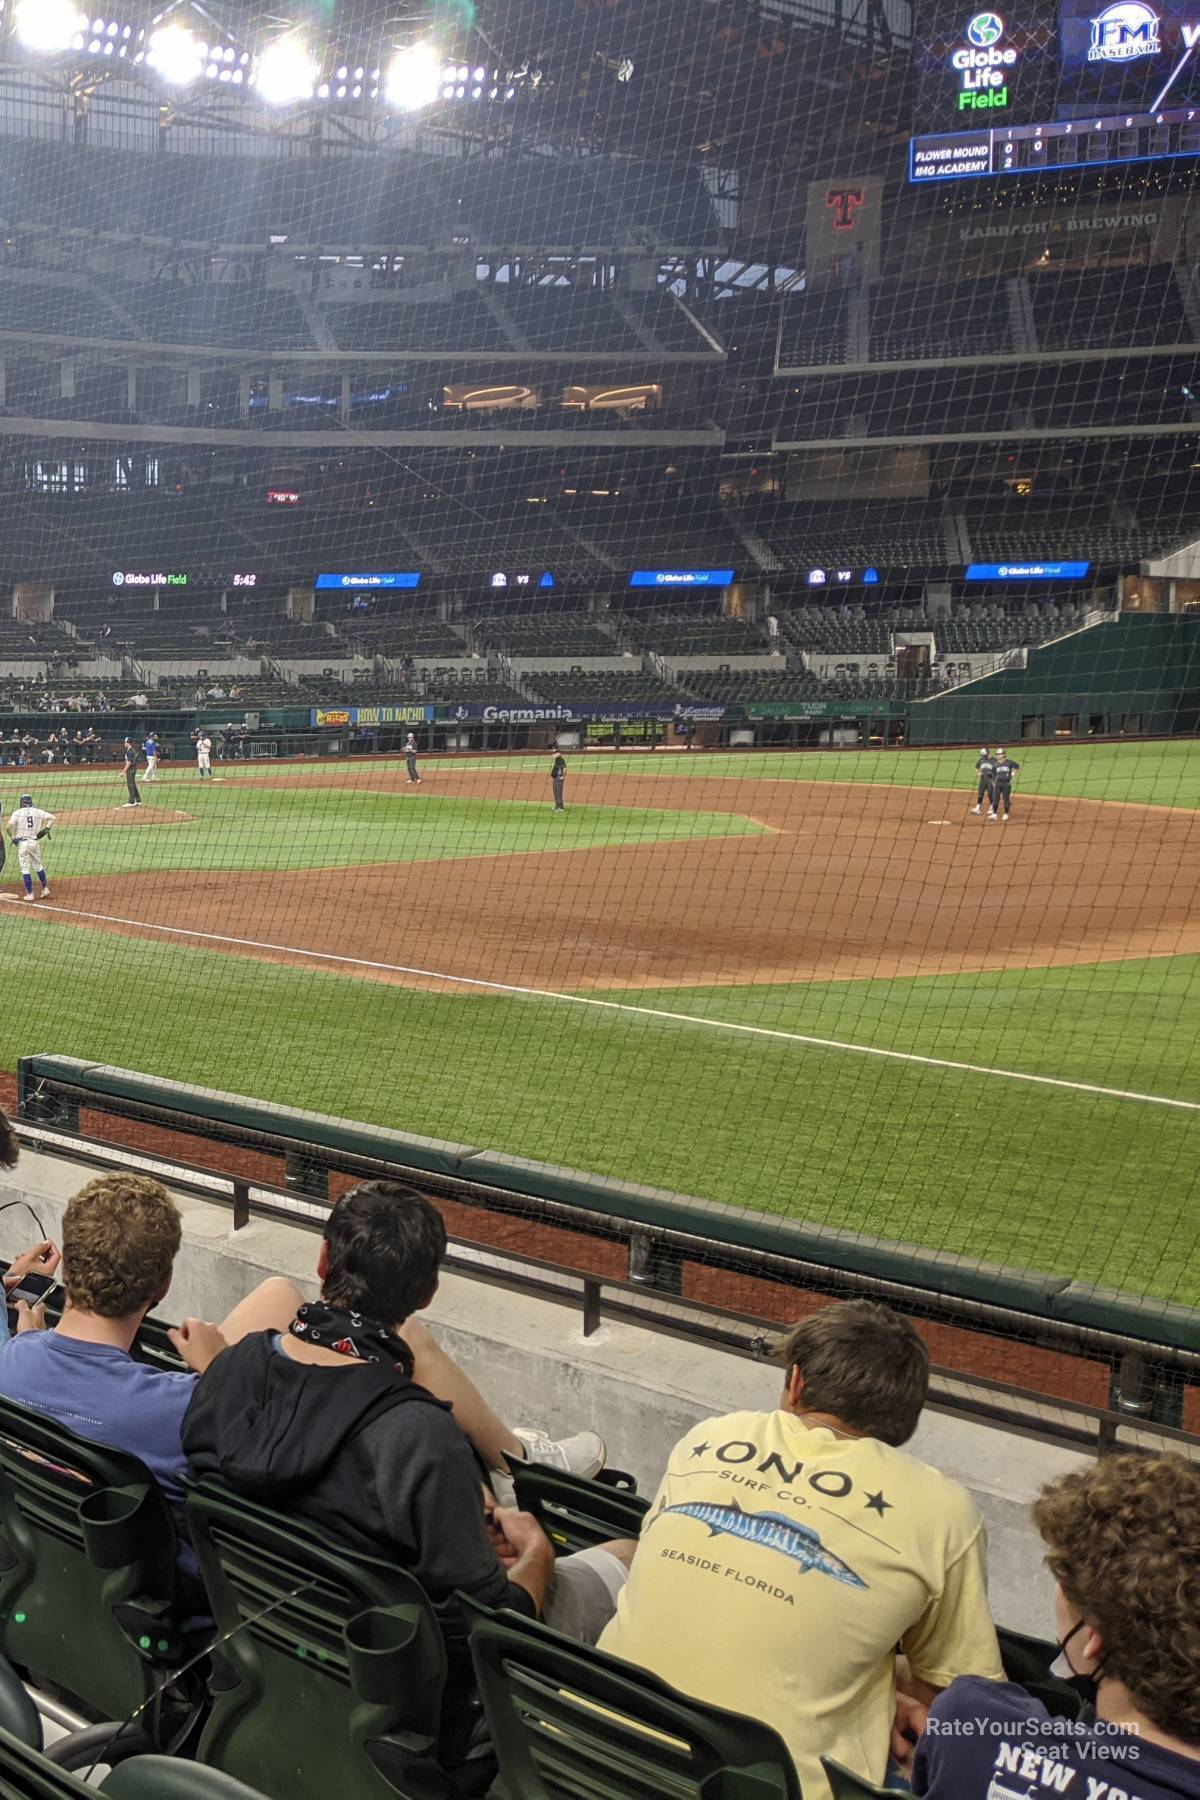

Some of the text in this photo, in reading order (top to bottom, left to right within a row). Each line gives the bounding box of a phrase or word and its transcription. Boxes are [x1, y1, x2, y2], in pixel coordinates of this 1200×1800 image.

[1097, 19, 1152, 46] FM
[953, 48, 1017, 69] Globe
[1089, 42, 1161, 60] BASEBALL
[964, 68, 1004, 89] Life
[958, 87, 1008, 110] Field
[1007, 111, 1195, 139] 1 2 3 4 5 6 7
[915, 141, 1042, 162] FLOWER MOUND 0 0
[915, 158, 1012, 177] IMG ACADEMY 2
[1066, 213, 1158, 232] BREWING
[125, 573, 187, 585] Globe Life Field
[233, 574, 257, 586] 5:42
[517, 575, 530, 584] VS
[838, 571, 851, 580] VS
[357, 707, 425, 722] HOW TO NACHO
[483, 705, 573, 719] Germania
[688, 706, 725, 715] Germania
[26, 815, 34, 828] 9
[715, 1440, 853, 1498] ONO
[718, 1469, 812, 1510] SURF CO.
[660, 1547, 796, 1606] SEASIDE FLORIDA
[994, 1741, 1146, 1800] NEW YO
